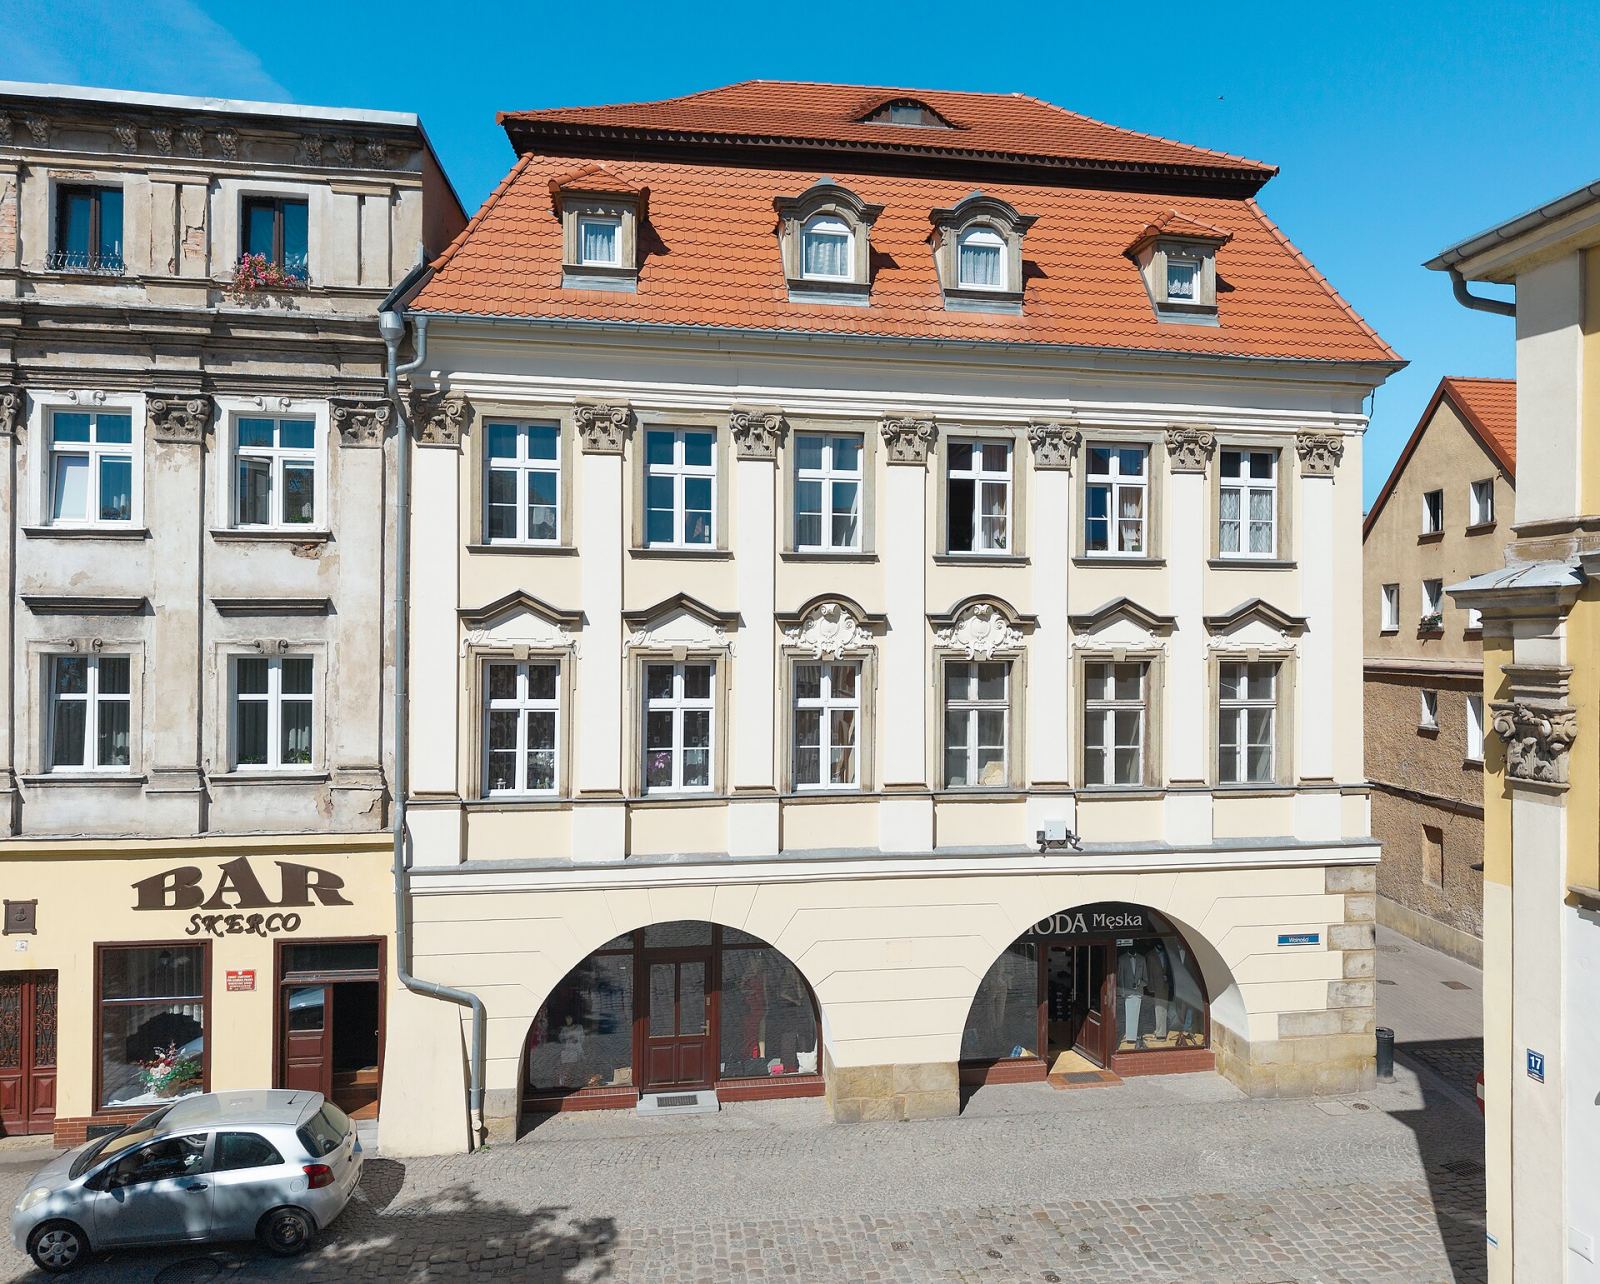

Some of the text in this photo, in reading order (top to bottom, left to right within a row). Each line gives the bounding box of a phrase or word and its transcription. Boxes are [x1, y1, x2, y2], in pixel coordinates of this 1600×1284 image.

[131, 856, 354, 911] BAR
[185, 913, 301, 937] SKERCO
[1093, 913, 1142, 929] Męska
[1530, 1056, 1541, 1070] 17
